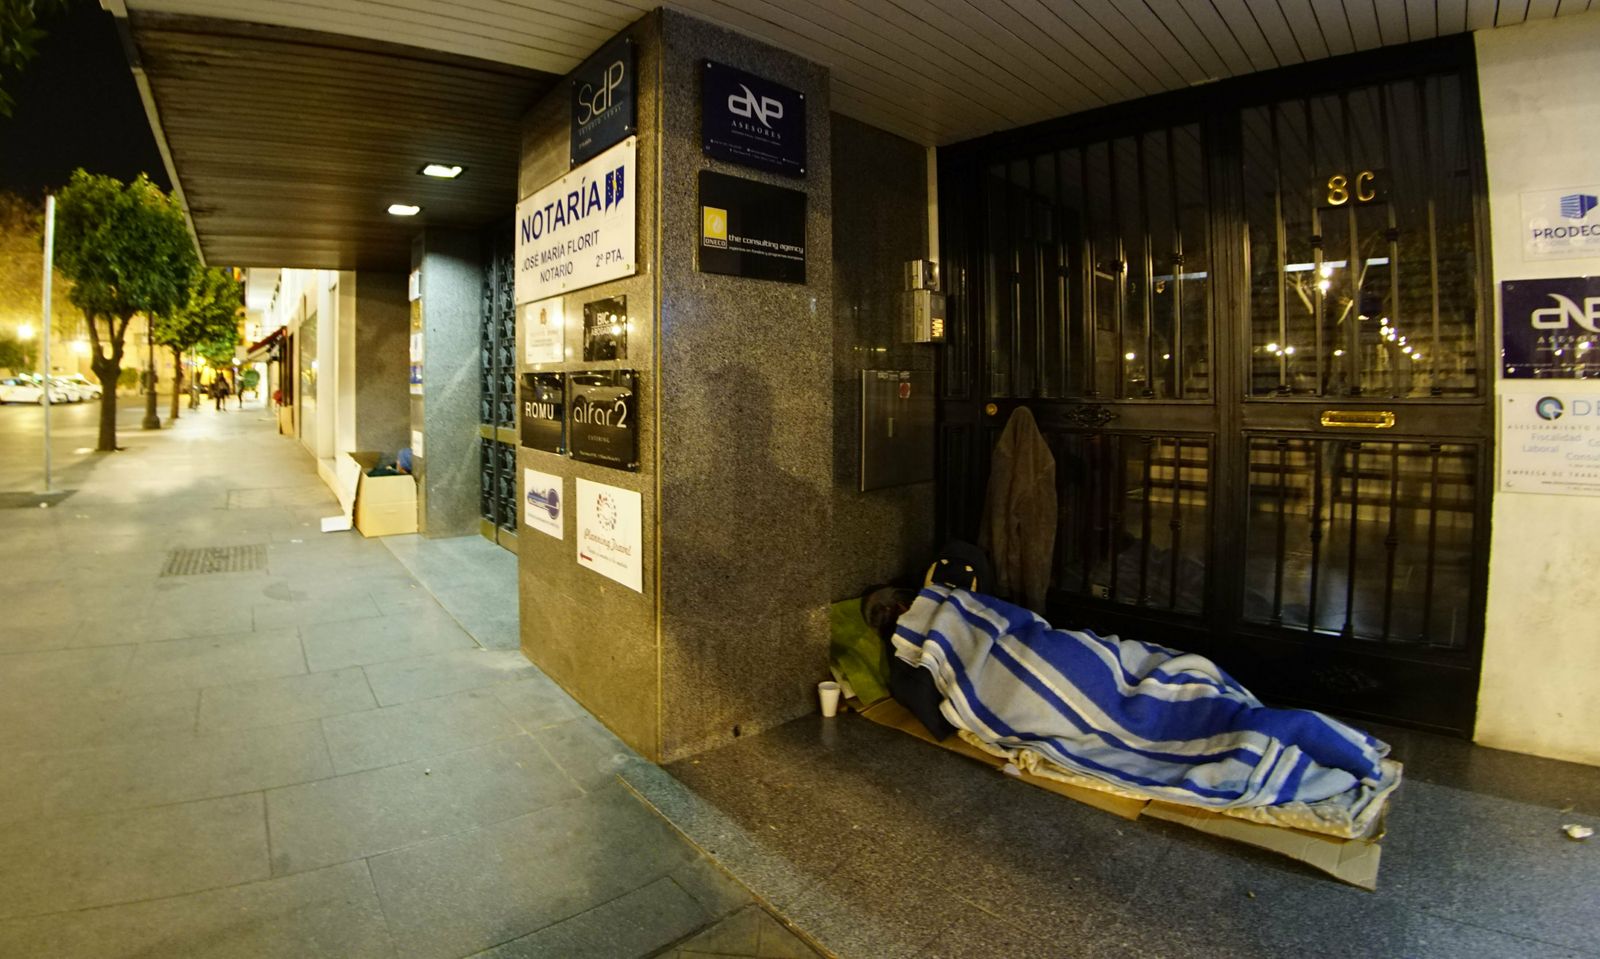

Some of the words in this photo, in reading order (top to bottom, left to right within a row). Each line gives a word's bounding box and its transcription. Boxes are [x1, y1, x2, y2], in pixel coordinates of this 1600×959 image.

[578, 60, 624, 125] SdP
[731, 120, 781, 140] ASESORES
[521, 176, 602, 246] NOTARÍA
[567, 229, 600, 256] FLORIT
[728, 234, 742, 243] the
[742, 237, 779, 250] consulting
[779, 243, 804, 254] agency
[605, 248, 625, 265] PTA.
[540, 261, 574, 284] NOTARIO
[525, 401, 554, 420] ROMU
[1522, 444, 1560, 453] Laboral
